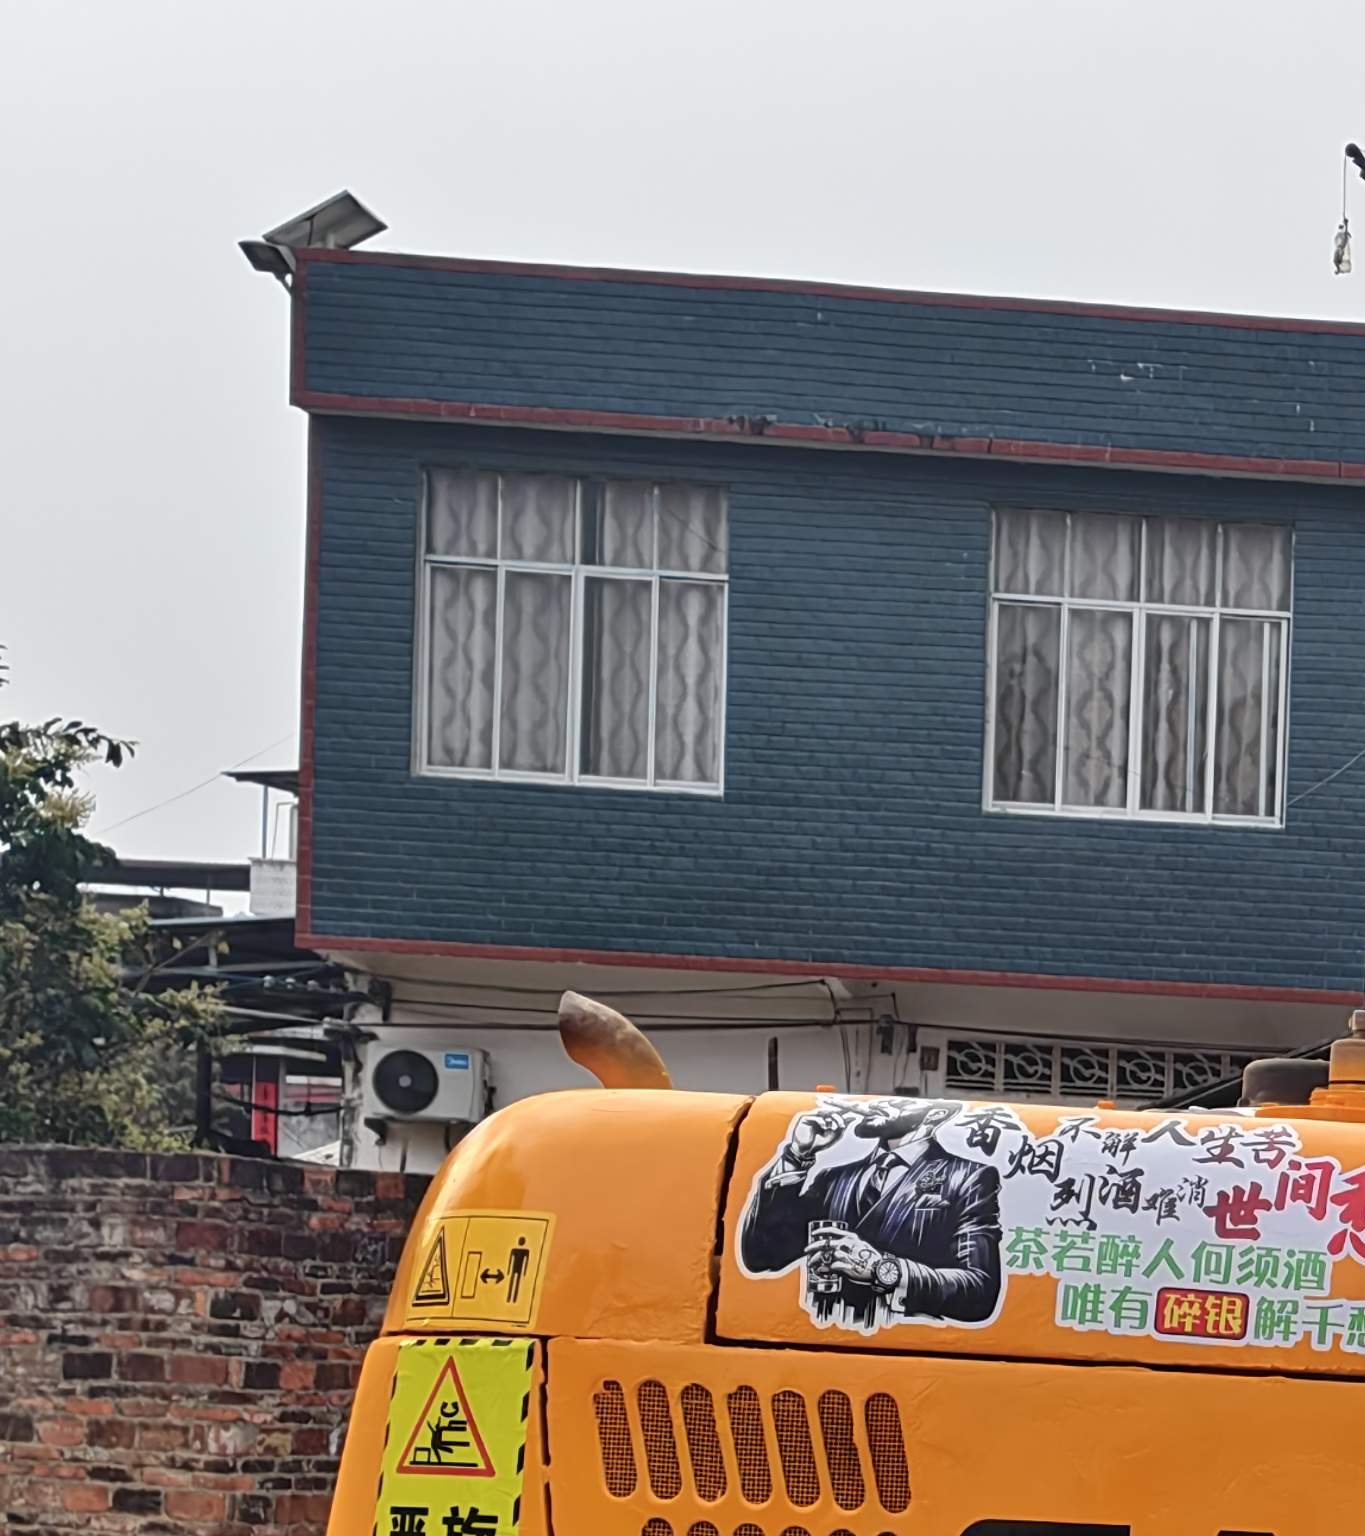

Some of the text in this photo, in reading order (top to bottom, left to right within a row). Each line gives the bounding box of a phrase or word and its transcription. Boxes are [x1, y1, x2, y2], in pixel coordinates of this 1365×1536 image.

[1005, 1226, 1328, 1291] 茶若醉人何须酒
